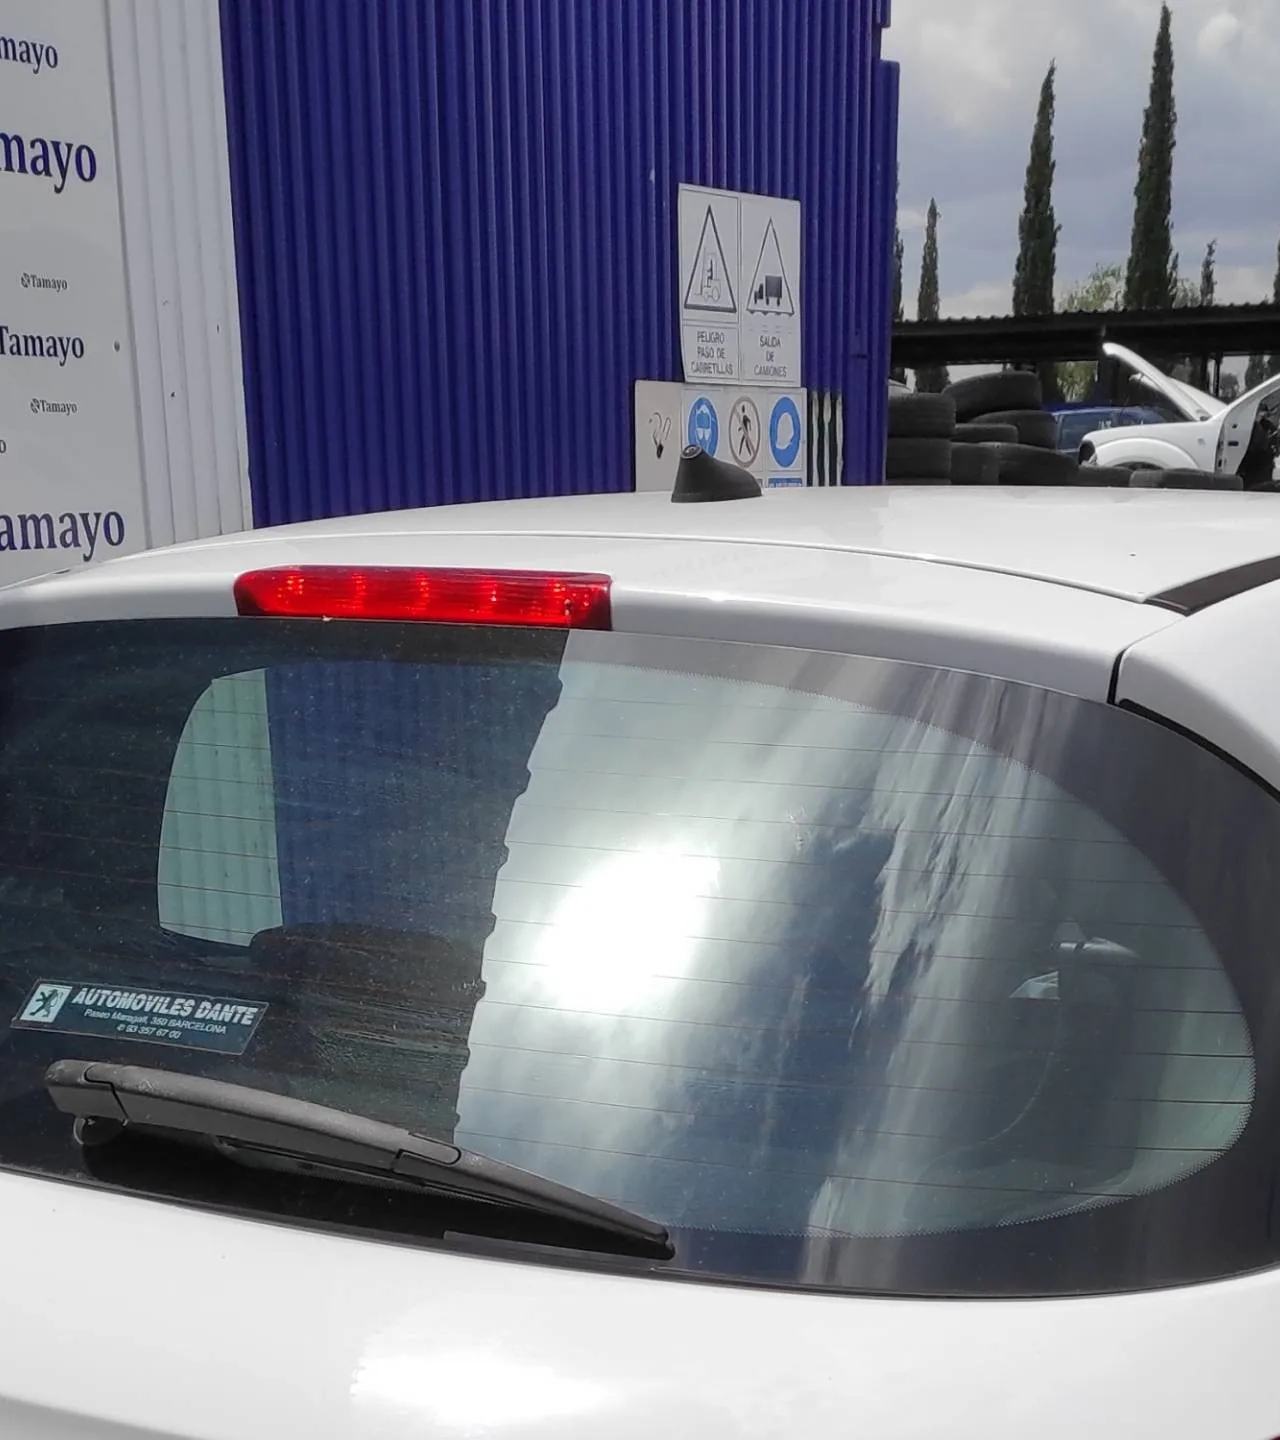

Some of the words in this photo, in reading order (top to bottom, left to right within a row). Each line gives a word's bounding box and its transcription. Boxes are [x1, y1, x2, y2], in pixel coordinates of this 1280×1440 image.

[28, 274, 68, 293] Tamayo
[697, 331, 725, 344] PELIGRO
[760, 336, 781, 348] SALIDA
[697, 347, 714, 359] PASO
[717, 348, 725, 359] DE
[766, 351, 774, 362] DE
[37, 399, 78, 417] Tamayo
[72, 987, 194, 1017] AUTOMOVILES
[194, 1002, 260, 1025] DANTE
[168, 1019, 227, 1034] BARCELONA
